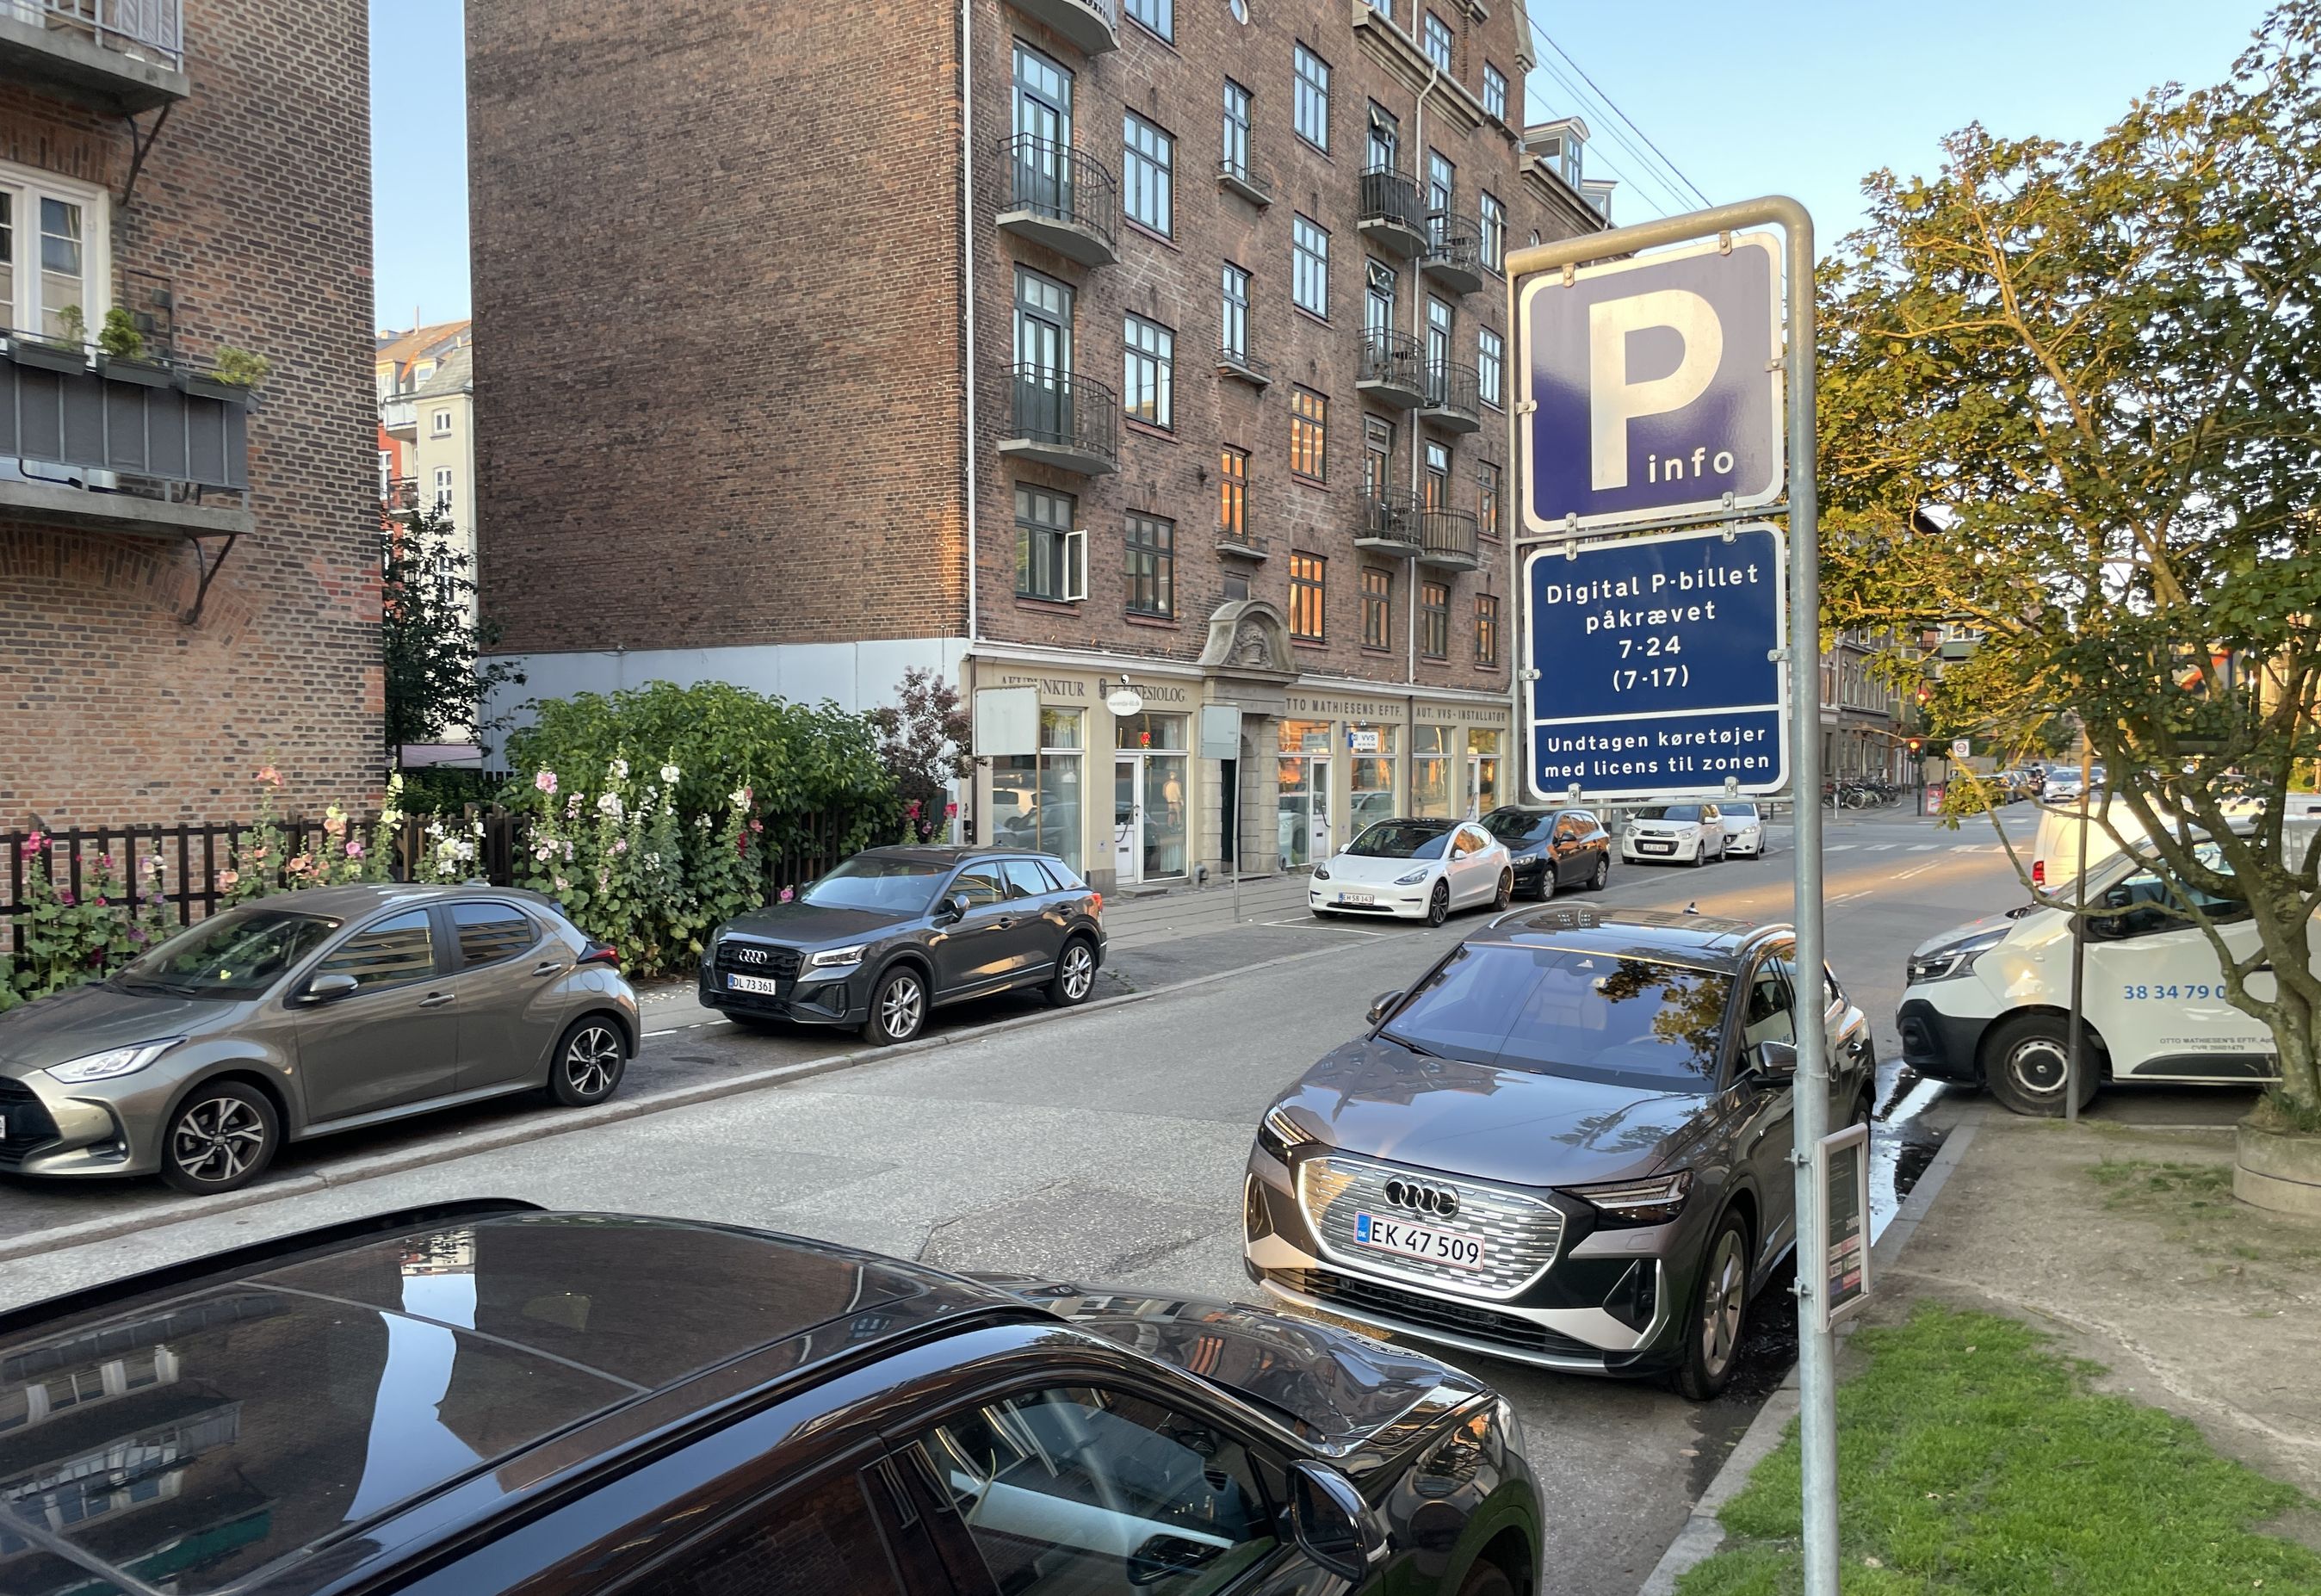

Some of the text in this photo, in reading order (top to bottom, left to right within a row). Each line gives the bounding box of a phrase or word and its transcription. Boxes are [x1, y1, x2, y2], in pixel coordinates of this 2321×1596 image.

[1589, 288, 1724, 491] P
[1648, 447, 1735, 484] info
[1547, 564, 1758, 604] Digital P-billet
[1586, 600, 1716, 634] påkrævet
[1619, 635, 1681, 659] 7-24
[1613, 664, 1689, 692] (7-17)
[1313, 700, 1374, 715] MATHIESENS
[1548, 727, 1766, 752] Undtagen køretøjer
[1544, 756, 1769, 778] med licens til zonen
[733, 977, 772, 992] DL 73 361
[2123, 985, 2225, 999] 38 34 79 0
[1358, 1230, 1367, 1239] DK
[1371, 1221, 1479, 1264] EK 47 509
